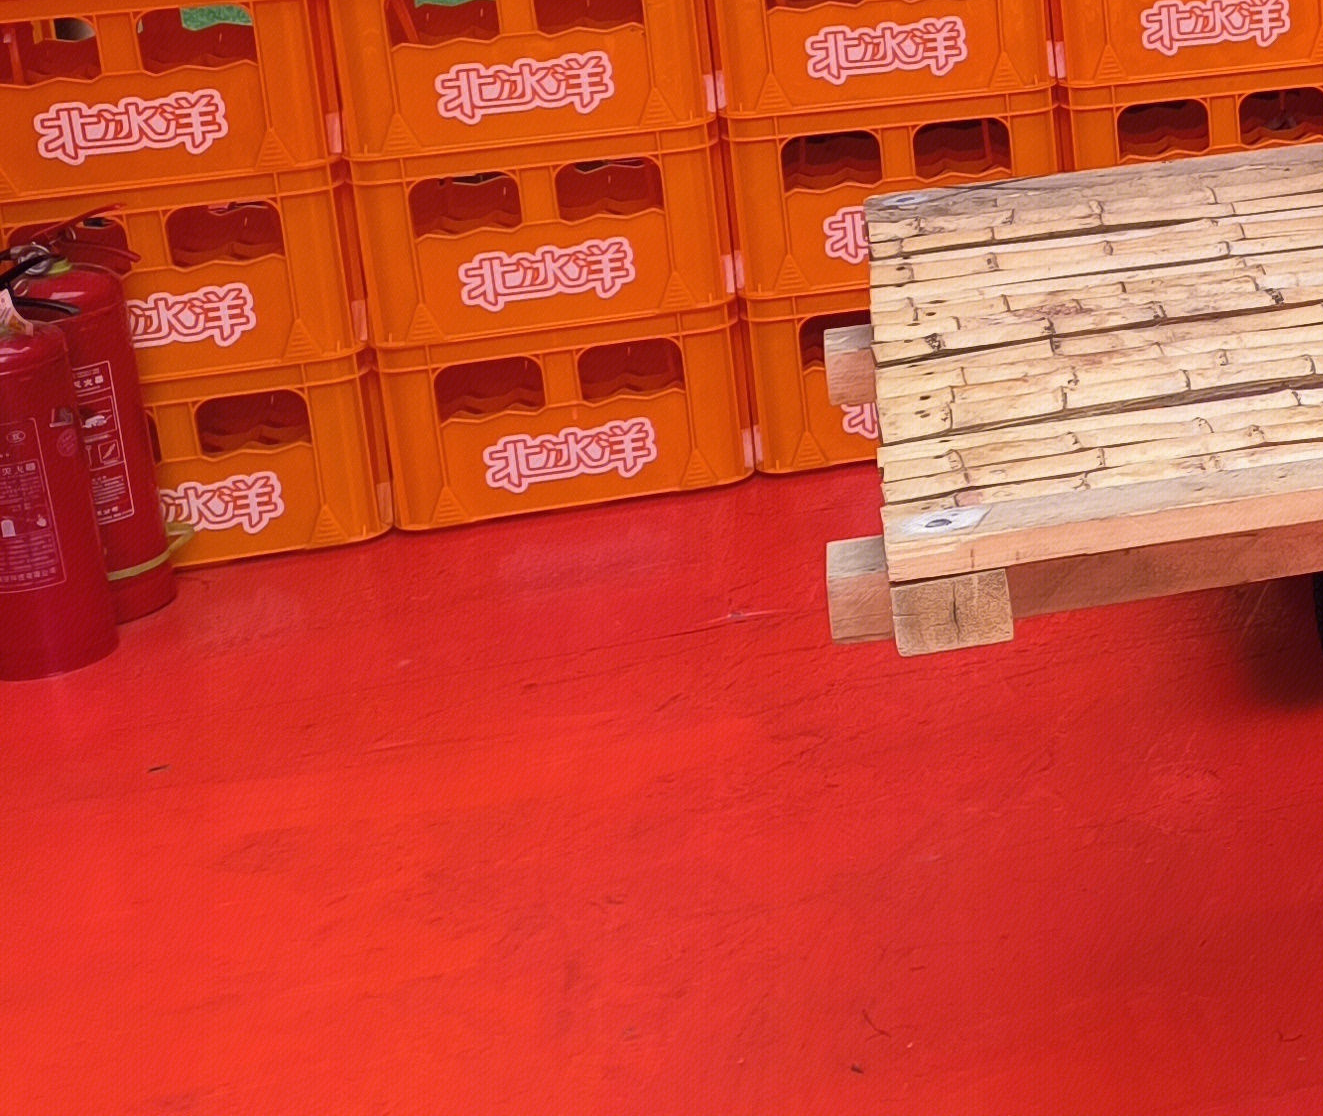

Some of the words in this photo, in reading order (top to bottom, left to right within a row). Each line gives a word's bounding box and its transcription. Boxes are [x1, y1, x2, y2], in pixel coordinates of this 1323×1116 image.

[805, 16, 968, 85] 北冰洋
[435, 51, 615, 125] 北冰洋
[34, 89, 228, 165] 北冰洋
[459, 237, 636, 312] 北冰洋
[127, 283, 256, 348] 冰洋
[483, 417, 657, 493] 北冰洋
[160, 472, 285, 535] 冰洋
